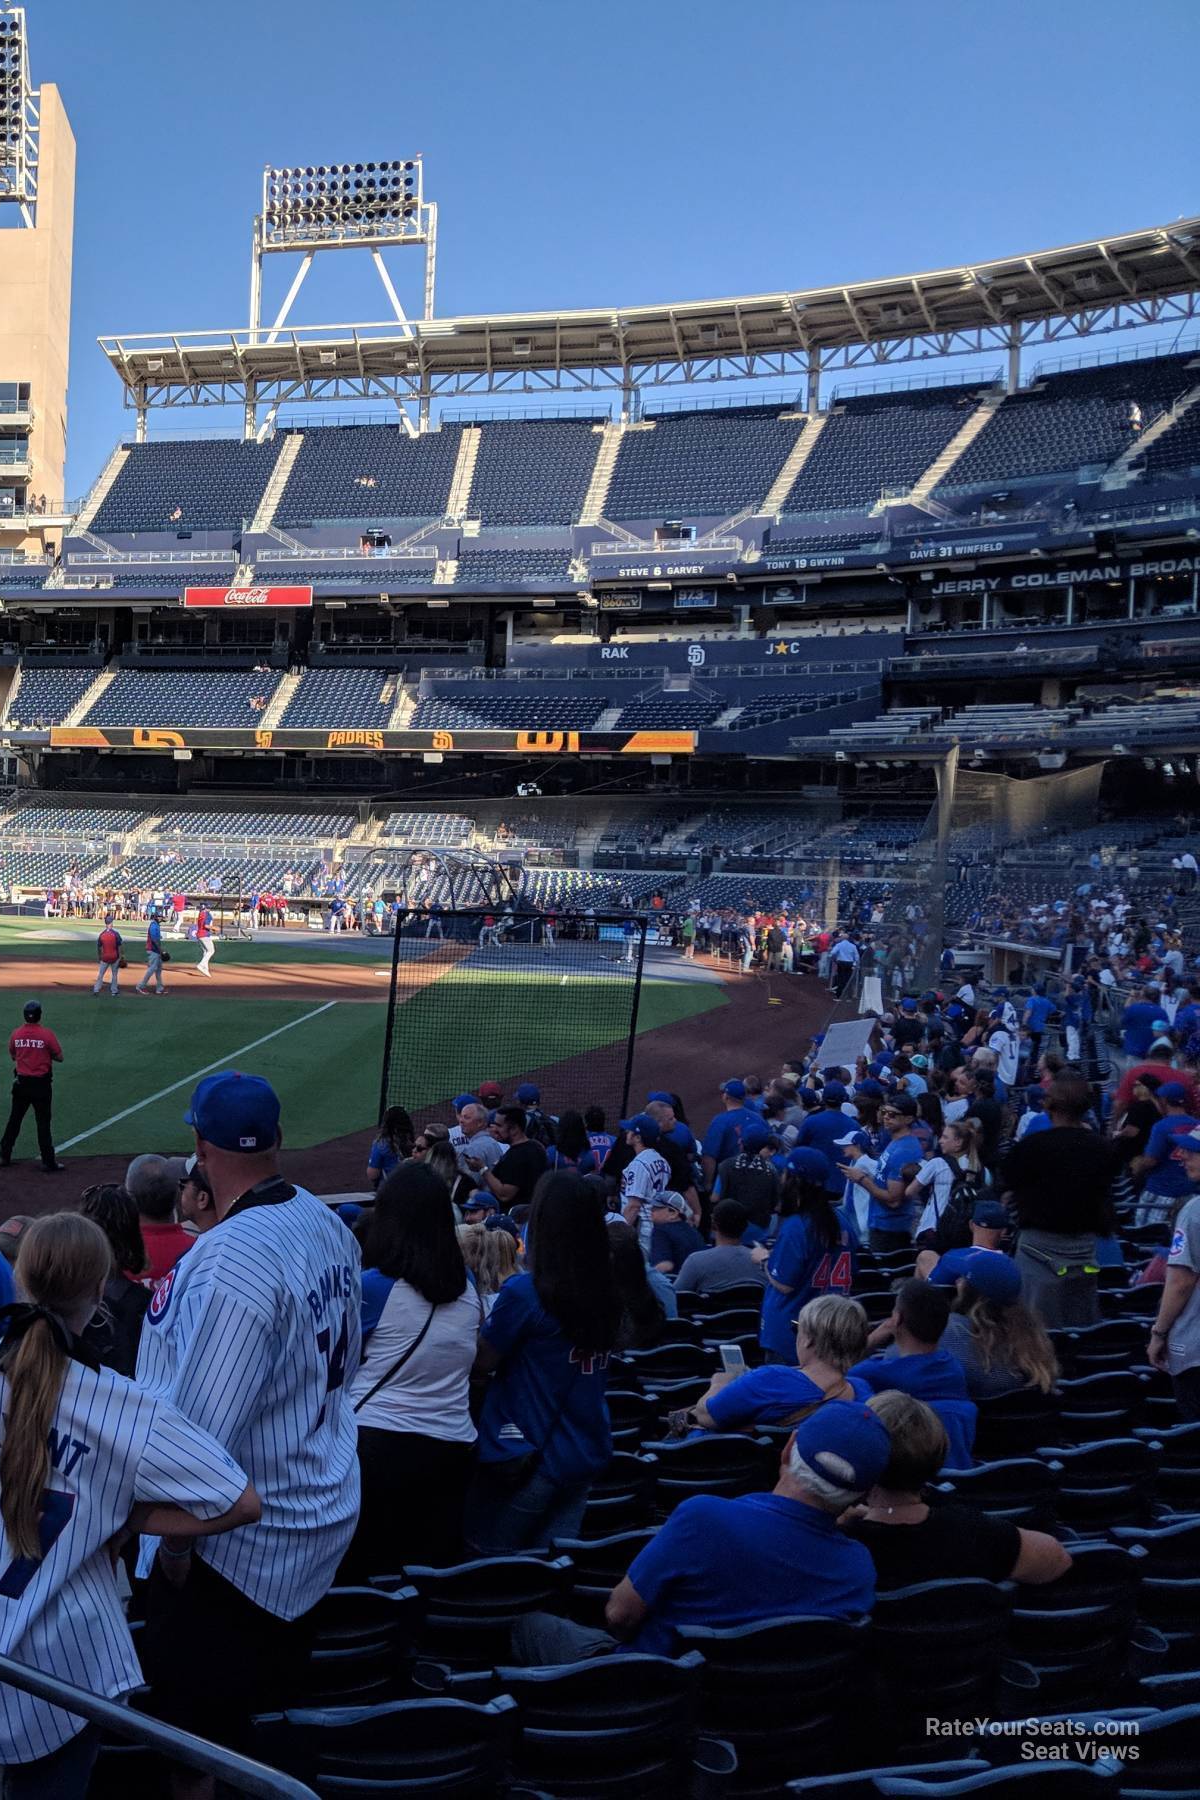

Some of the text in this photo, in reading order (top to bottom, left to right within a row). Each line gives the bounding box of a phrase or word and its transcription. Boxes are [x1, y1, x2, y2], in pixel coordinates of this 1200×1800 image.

[910, 542, 1004, 559] DAVE 31 WINFIELD
[619, 566, 705, 577] STEVE 6 GARVEY
[766, 557, 845, 570] TONY 19 GWYNN
[932, 577, 1000, 595] JERRY
[1011, 566, 1121, 588] COLEMAN
[601, 647, 629, 659] RAK
[327, 731, 384, 748] PADRES
[14, 1038, 45, 1049] ELITE
[811, 1251, 853, 1297] 44
[307, 1264, 353, 1324] BANKS
